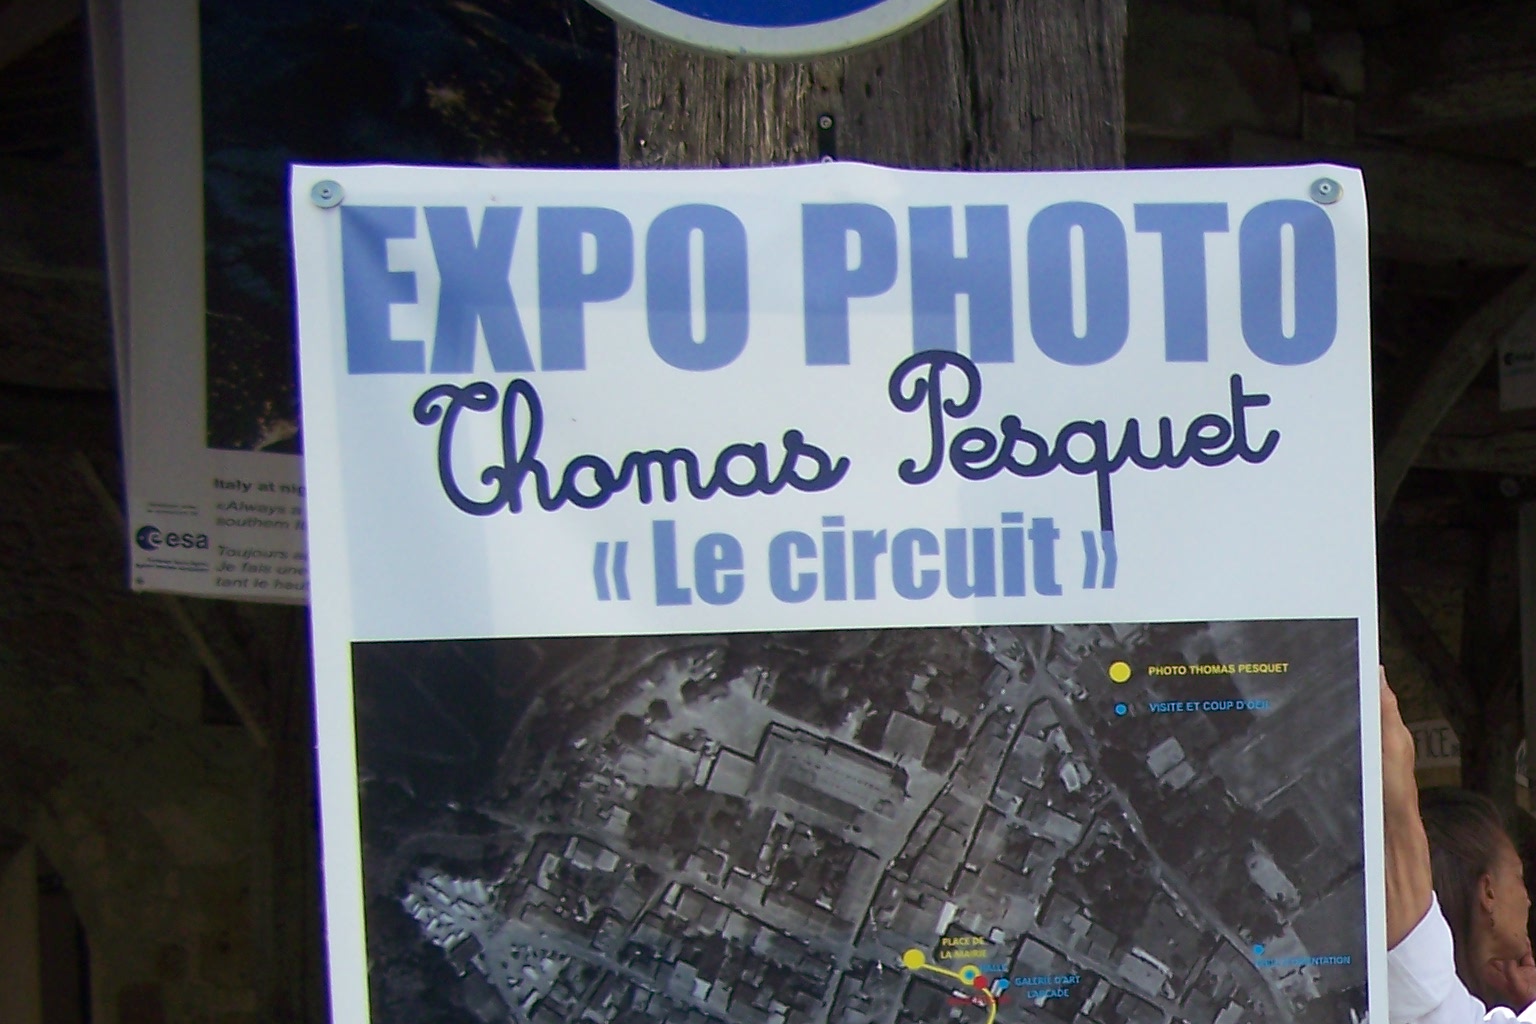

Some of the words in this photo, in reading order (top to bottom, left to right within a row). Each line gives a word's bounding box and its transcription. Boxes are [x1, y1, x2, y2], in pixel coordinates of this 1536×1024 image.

[340, 202, 751, 374] EXPO
[799, 198, 1339, 367] PHOTO
[412, 378, 850, 516] Thomas
[888, 349, 1281, 532] Pesquet
[213, 479, 253, 493] Italy
[166, 532, 209, 549] esa
[654, 518, 745, 606] Le
[768, 511, 1062, 601] circuit
[1147, 665, 1187, 676] PHOTO
[1189, 663, 1236, 675] THOMAS
[1238, 662, 1290, 674] PESQUET
[1148, 701, 1184, 713] VISITE
[1186, 700, 1201, 712] ET
[1202, 700, 1234, 711] COUP
[942, 937, 971, 947] PLACE
[972, 937, 986, 946] DE
[940, 951, 953, 959] LA
[1014, 977, 1052, 986] GALERIE
[1054, 975, 1081, 985] D'ART
